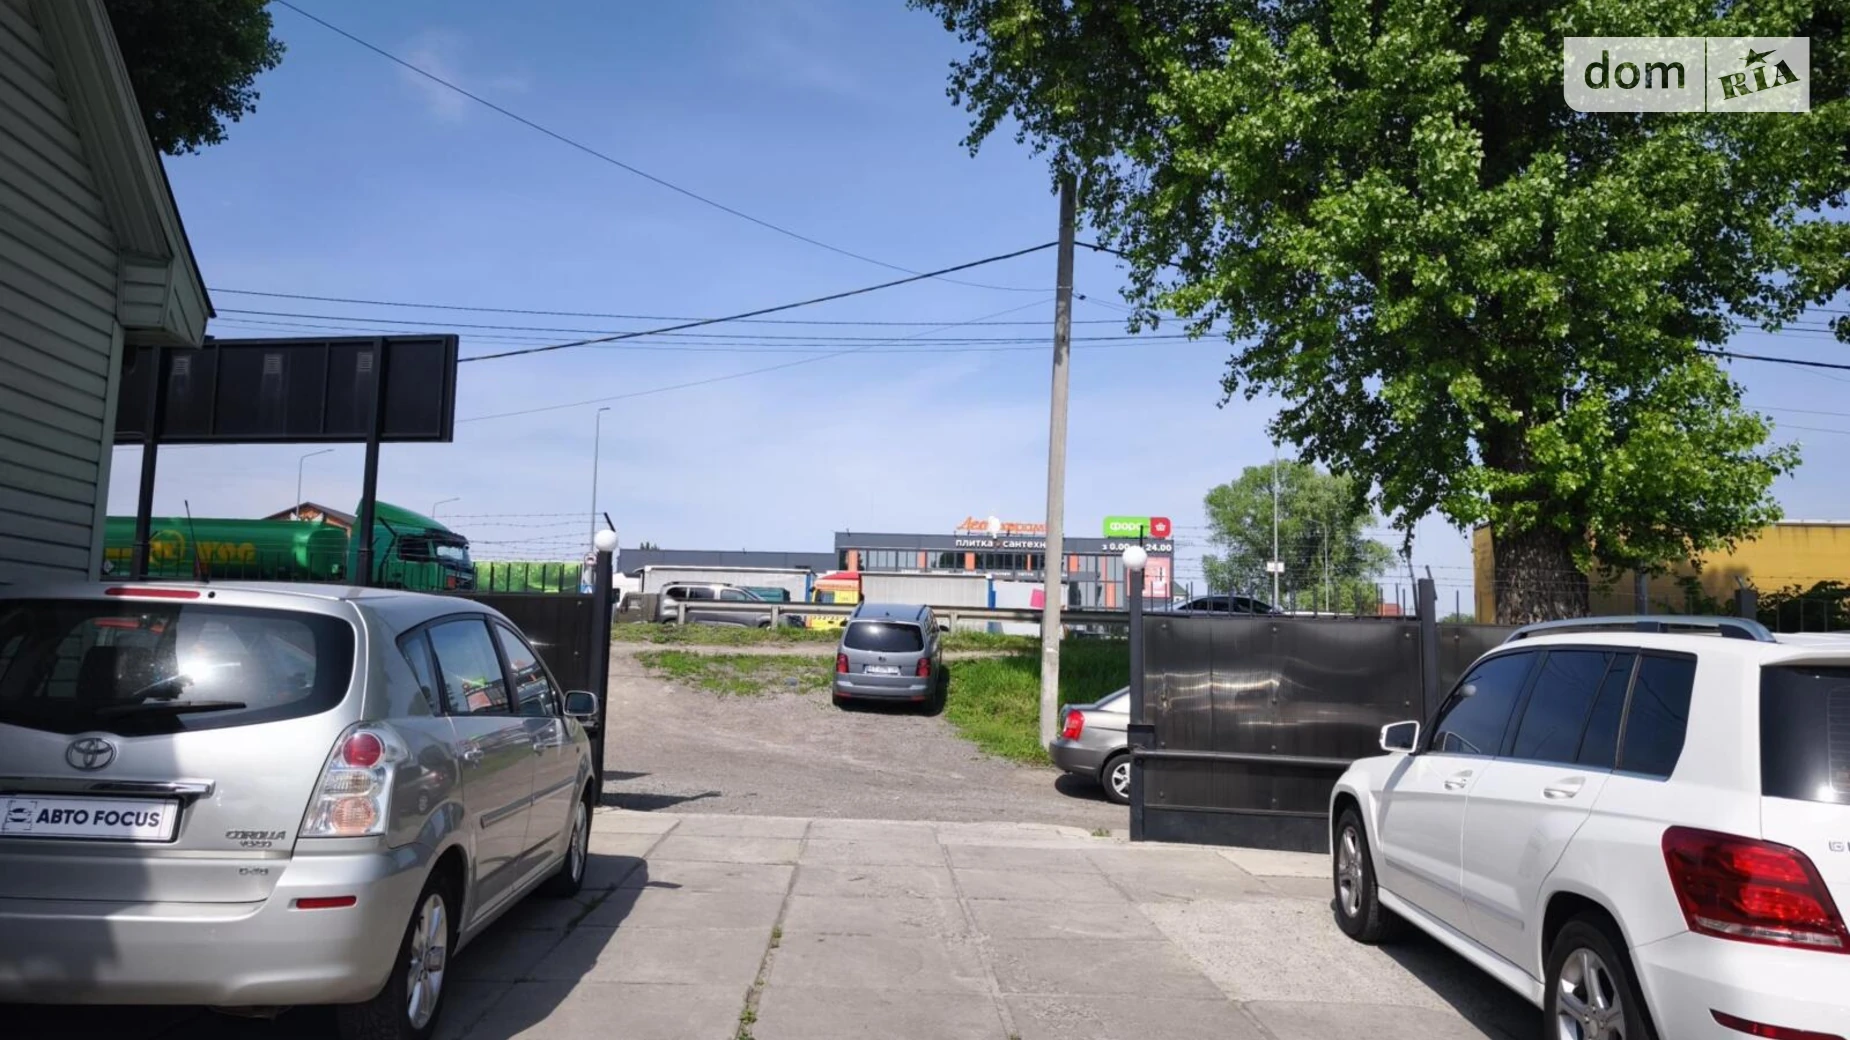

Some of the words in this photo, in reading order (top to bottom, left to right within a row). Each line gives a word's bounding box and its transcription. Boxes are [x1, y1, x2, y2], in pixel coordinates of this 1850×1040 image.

[955, 539, 993, 547] плитка
[1003, 540, 1046, 548] сантехн
[1146, 543, 1172, 551] 24.00
[36, 809, 89, 825] АВТО
[93, 810, 160, 828] FOCUS
[225, 830, 286, 840] COROLLA
